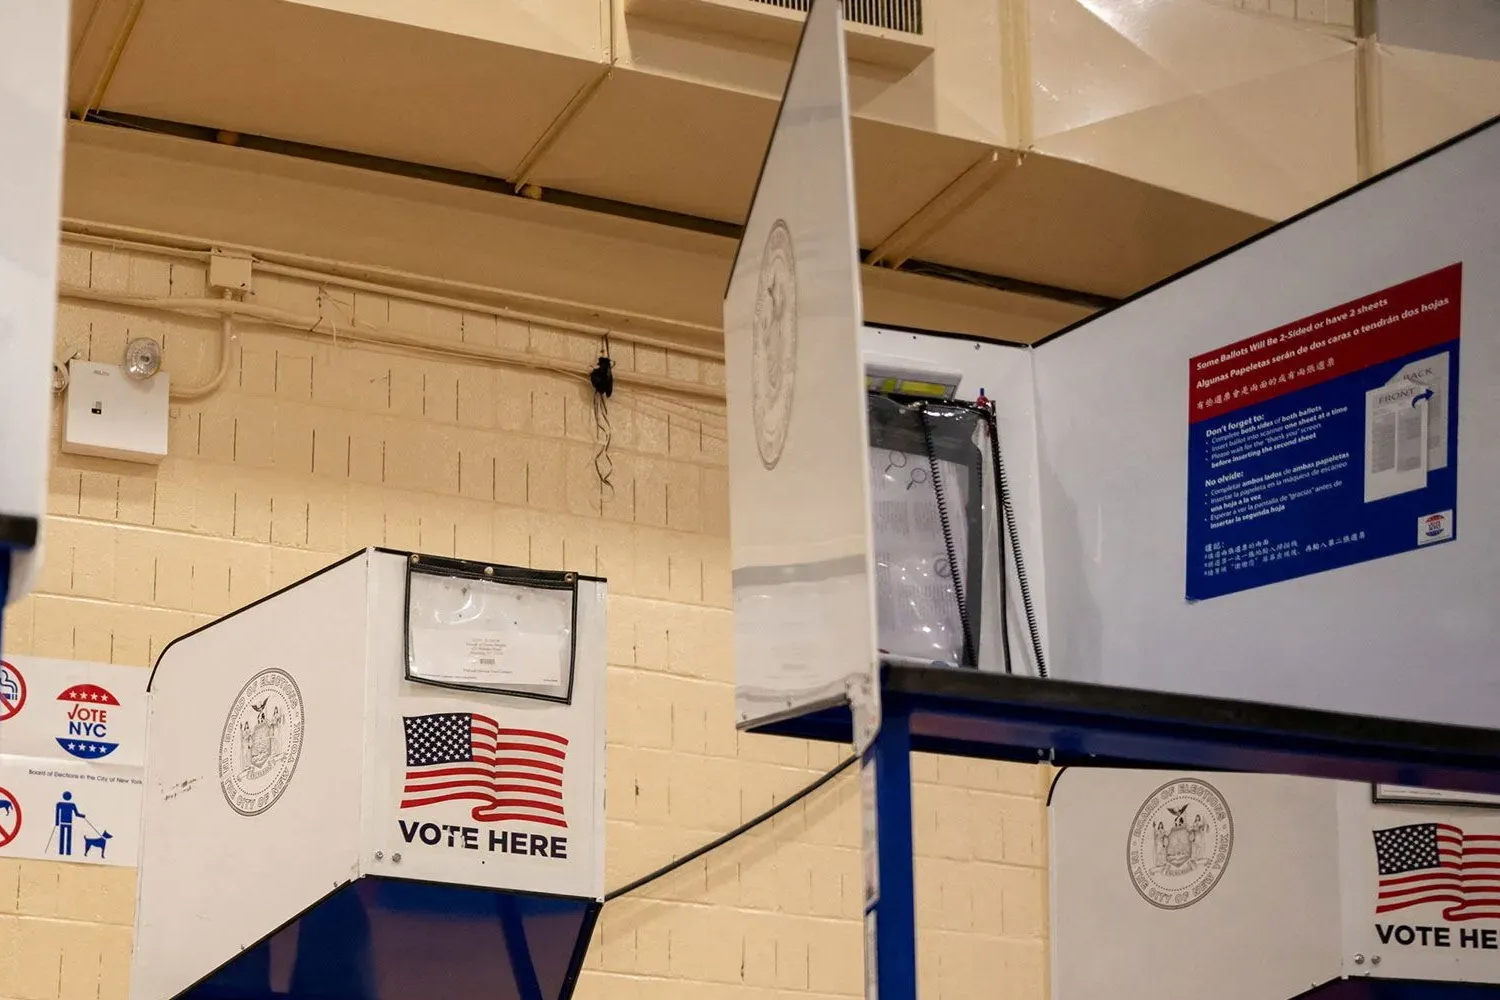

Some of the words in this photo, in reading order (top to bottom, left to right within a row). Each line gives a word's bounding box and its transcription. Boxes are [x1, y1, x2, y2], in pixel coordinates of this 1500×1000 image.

[1196, 357, 1219, 370] Some
[1219, 347, 1248, 362] Ballots
[1248, 339, 1265, 352] Will
[1266, 337, 1278, 346] Be
[1279, 322, 1312, 341] 2-Sided
[1313, 320, 1324, 329] or
[1325, 312, 1348, 325] have
[1349, 308, 1355, 317] 2
[1356, 298, 1388, 314] sheets
[1196, 372, 1229, 388] Algunas
[1229, 358, 1270, 377] Papeletas
[1271, 350, 1295, 363] serán
[1296, 345, 1308, 355] de
[1309, 339, 1326, 350] dos
[1327, 331, 1351, 344] caras
[1360, 314, 1399, 333] tendrán
[1400, 307, 1419, 319] dos
[1420, 297, 1449, 312] hojas
[1402, 368, 1434, 381] BACK
[1378, 387, 1416, 405] FRONT
[1211, 430, 1240, 444] Complete
[1240, 424, 1256, 434] both
[1256, 420, 1273, 429] sides
[1281, 412, 1298, 422] both
[1298, 405, 1322, 417] ballots
[1211, 441, 1228, 451] Insert
[1228, 436, 1246, 446] ballot
[1259, 425, 1283, 437] scanner
[1284, 421, 1297, 430] one
[1297, 414, 1317, 425] sheet
[1330, 405, 1348, 415] time
[1227, 416, 1252, 430] forget
[1252, 413, 1264, 422] to:
[1210, 450, 1230, 460] Please
[1229, 445, 1243, 454] wait
[1300, 422, 1321, 433] screen
[1210, 458, 1231, 468] before
[1232, 449, 1261, 462] inserting
[1273, 436, 1297, 450] second
[1297, 432, 1316, 442] sheet
[1204, 478, 1216, 487] No
[1216, 470, 1243, 484] olvide:
[1210, 482, 1240, 496] Completar
[1241, 476, 1263, 487] ambos
[1263, 471, 1282, 480] lados
[1292, 462, 1314, 472] ambas
[1315, 451, 1349, 467] papeletas
[1209, 510, 1232, 521] Esperar
[1253, 497, 1279, 509] pantalla
[1314, 482, 1332, 492] antes
[1210, 493, 1232, 504] Insertar
[1239, 484, 1266, 497] papeleta
[1210, 504, 1223, 512] una
[1222, 500, 1237, 509] hoja
[1210, 518, 1234, 529] Insertar
[1241, 507, 1270, 520] segunda
[1269, 504, 1285, 512] hoja
[67, 703, 107, 723] VOTE
[68, 720, 107, 738] NYC
[54, 771, 79, 779] Elections
[398, 819, 478, 851] VOTE
[488, 830, 568, 860] HERE
[1375, 924, 1450, 948] VOTE
[1460, 928, 1500, 950] HE
